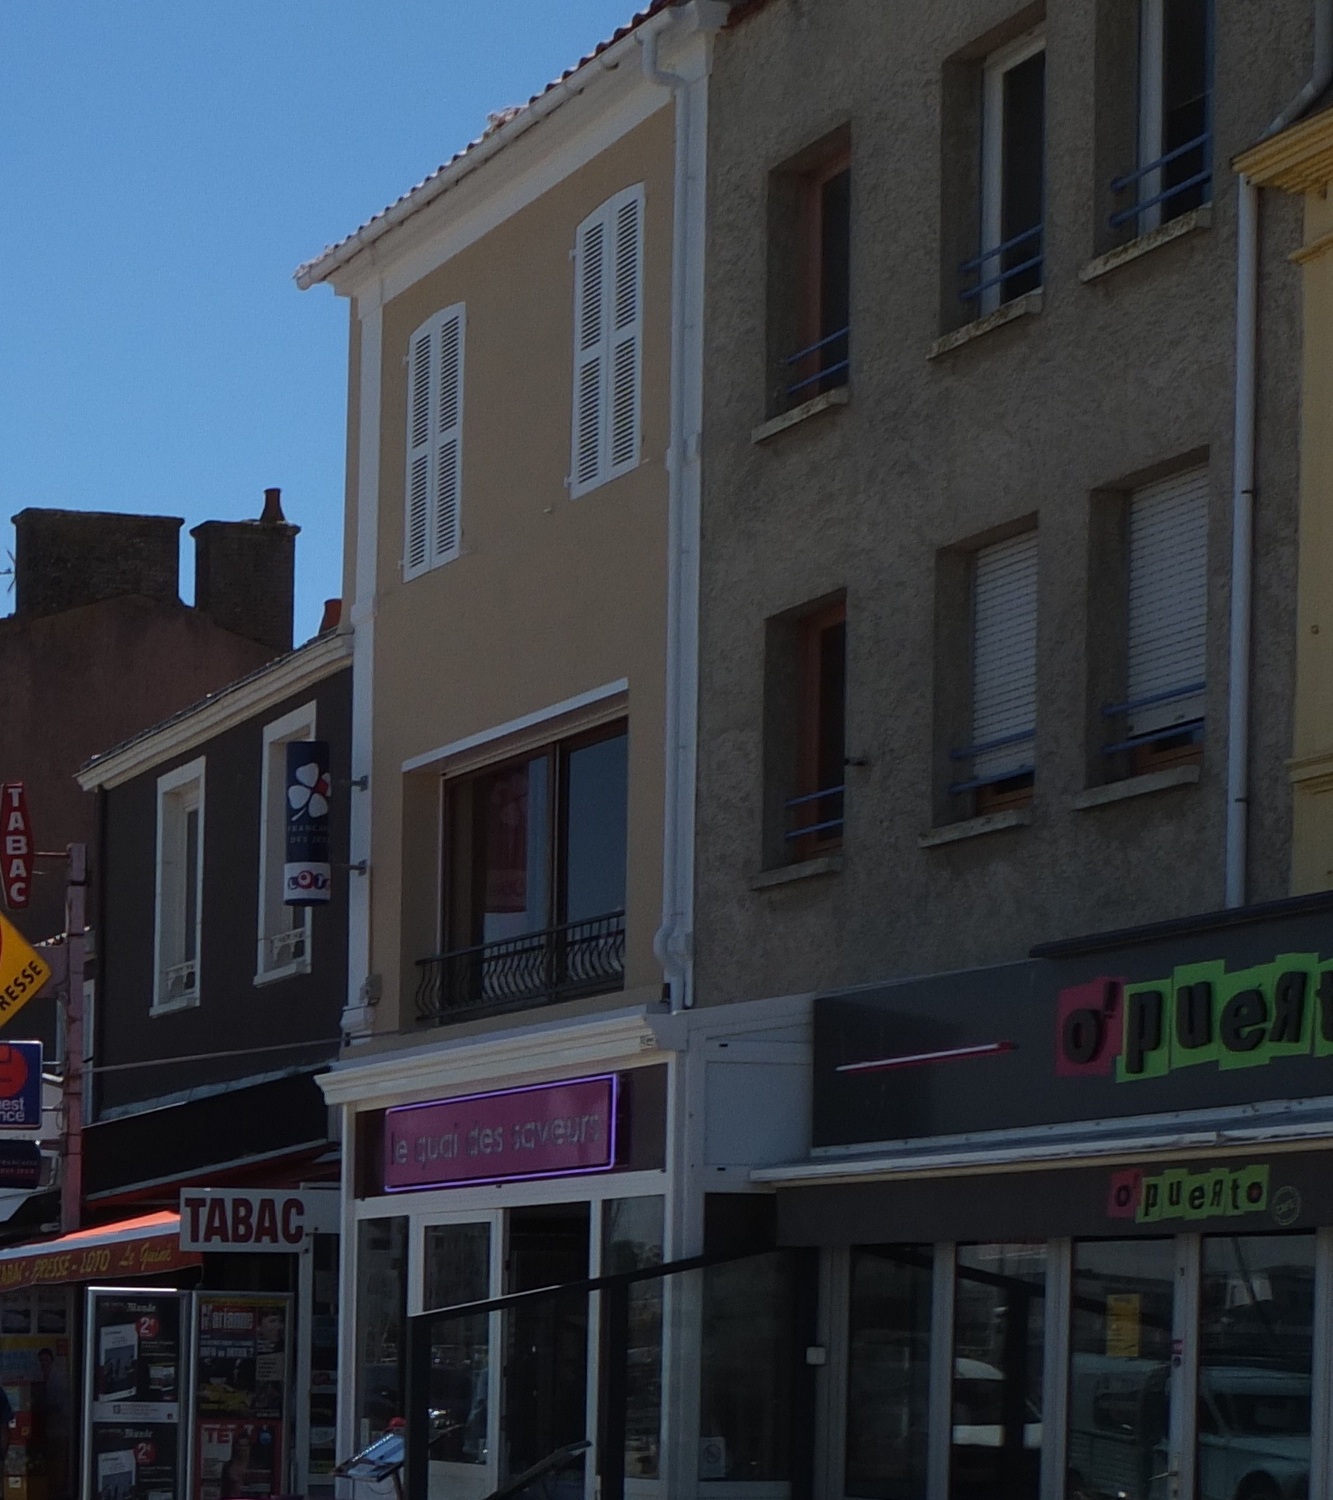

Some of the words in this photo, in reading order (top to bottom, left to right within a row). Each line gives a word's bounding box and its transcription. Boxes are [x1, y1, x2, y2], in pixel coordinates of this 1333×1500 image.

[5, 787, 29, 903] TABAC
[414, 1122, 458, 1169] quai
[466, 1121, 504, 1158] des
[511, 1112, 601, 1151] saveurs
[184, 1197, 304, 1243] TABAC
[30, 1254, 71, 1280] PRESSE
[80, 1248, 111, 1274] LOTO
